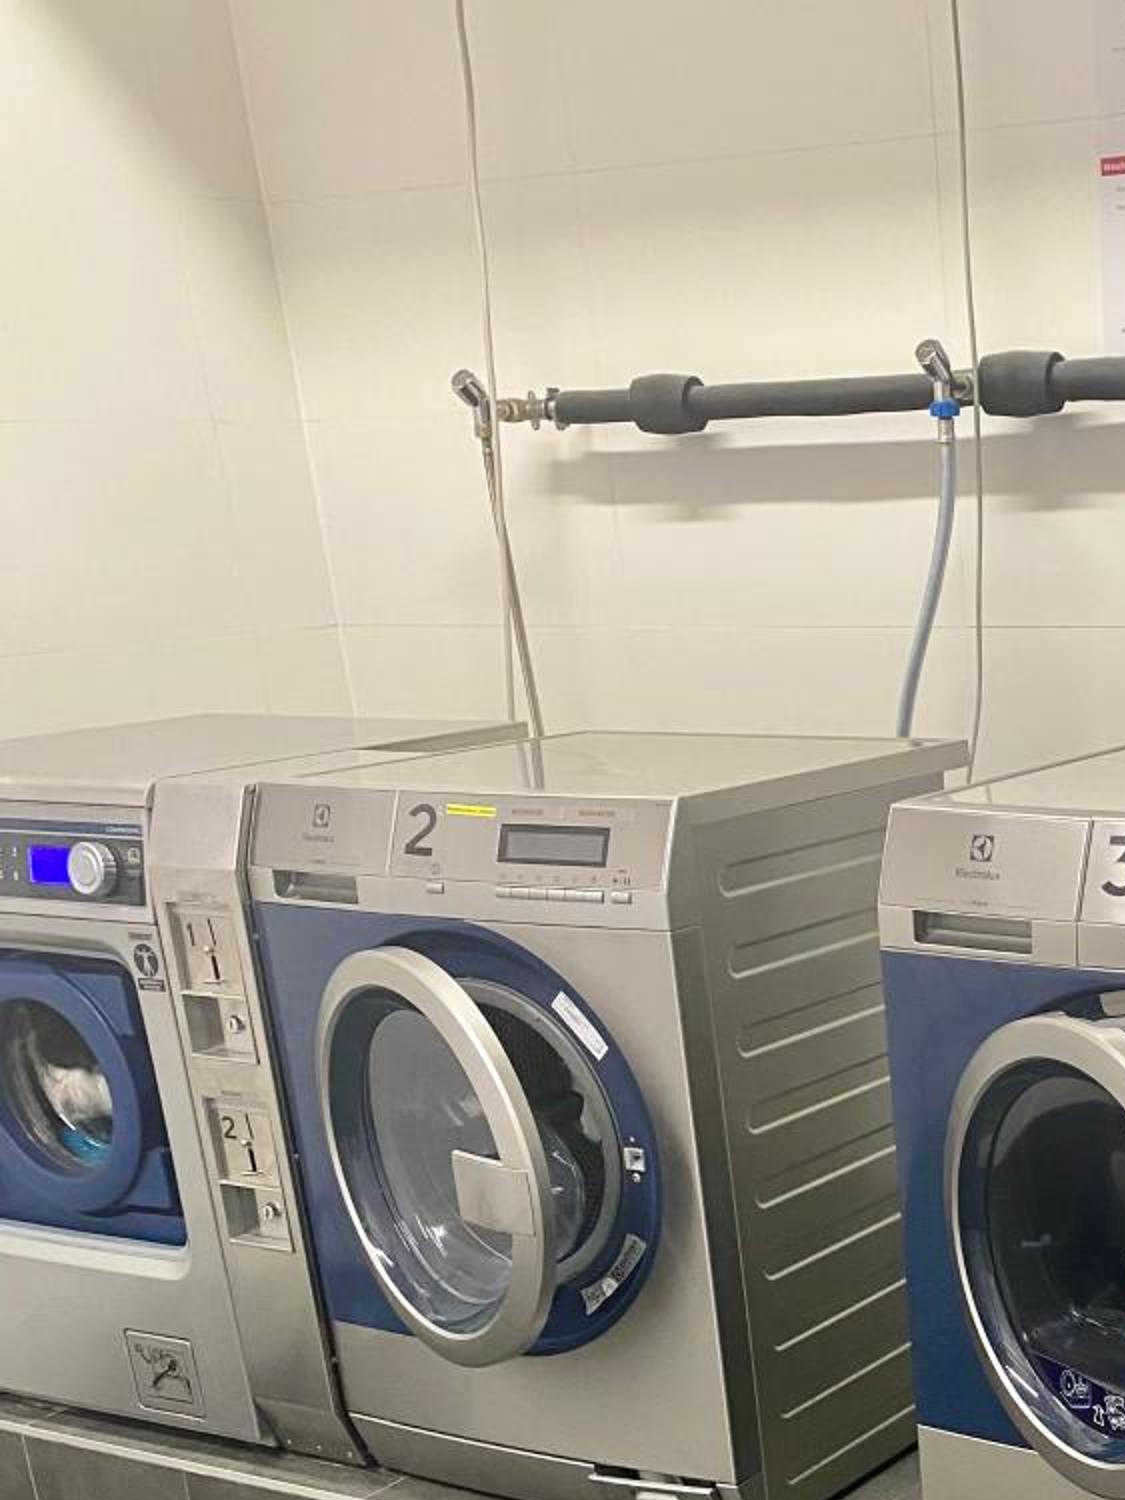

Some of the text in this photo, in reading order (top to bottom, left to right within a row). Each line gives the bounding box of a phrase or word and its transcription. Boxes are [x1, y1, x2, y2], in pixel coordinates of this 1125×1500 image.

[404, 802, 438, 857] 2
[186, 922, 197, 947] 1
[221, 1116, 237, 1140] 2
